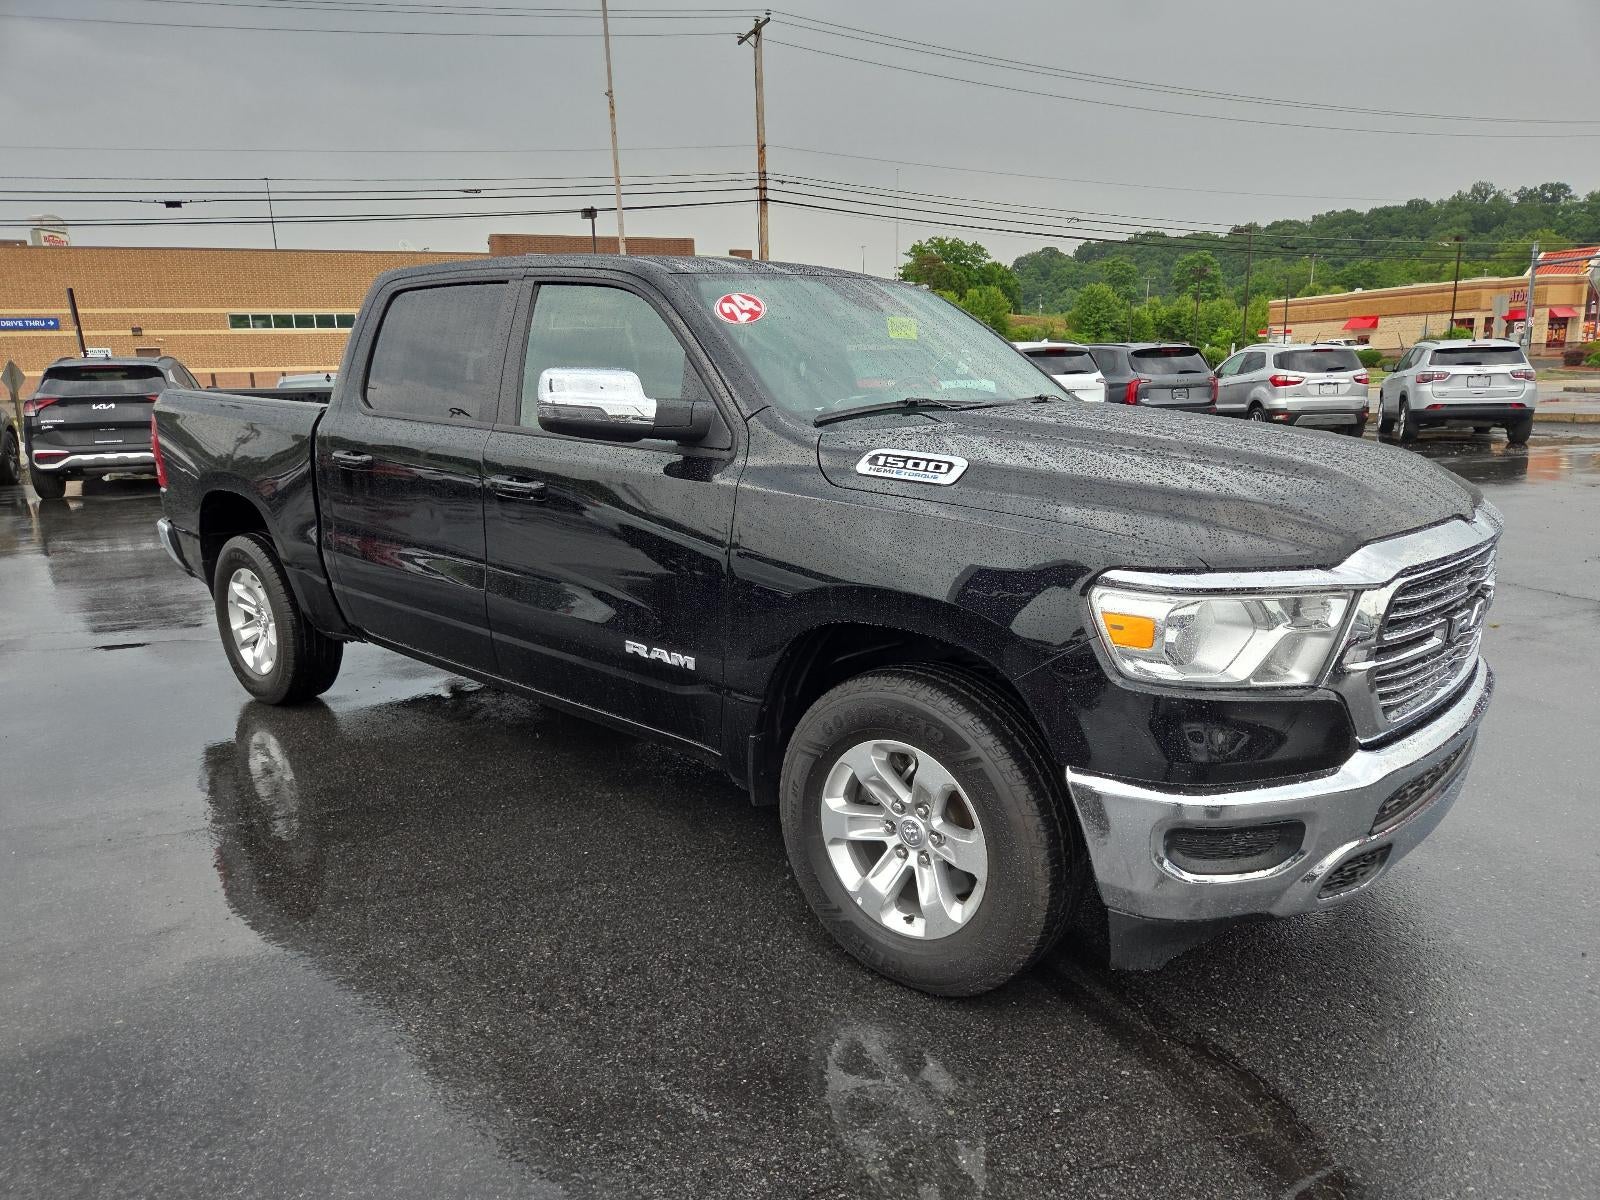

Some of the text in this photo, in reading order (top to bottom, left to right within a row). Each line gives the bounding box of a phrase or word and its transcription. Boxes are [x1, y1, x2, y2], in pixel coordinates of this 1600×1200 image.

[721, 294, 762, 322] 24
[868, 466, 895, 475] HEMI
[877, 455, 949, 474] 1500
[625, 639, 696, 671] RAM
